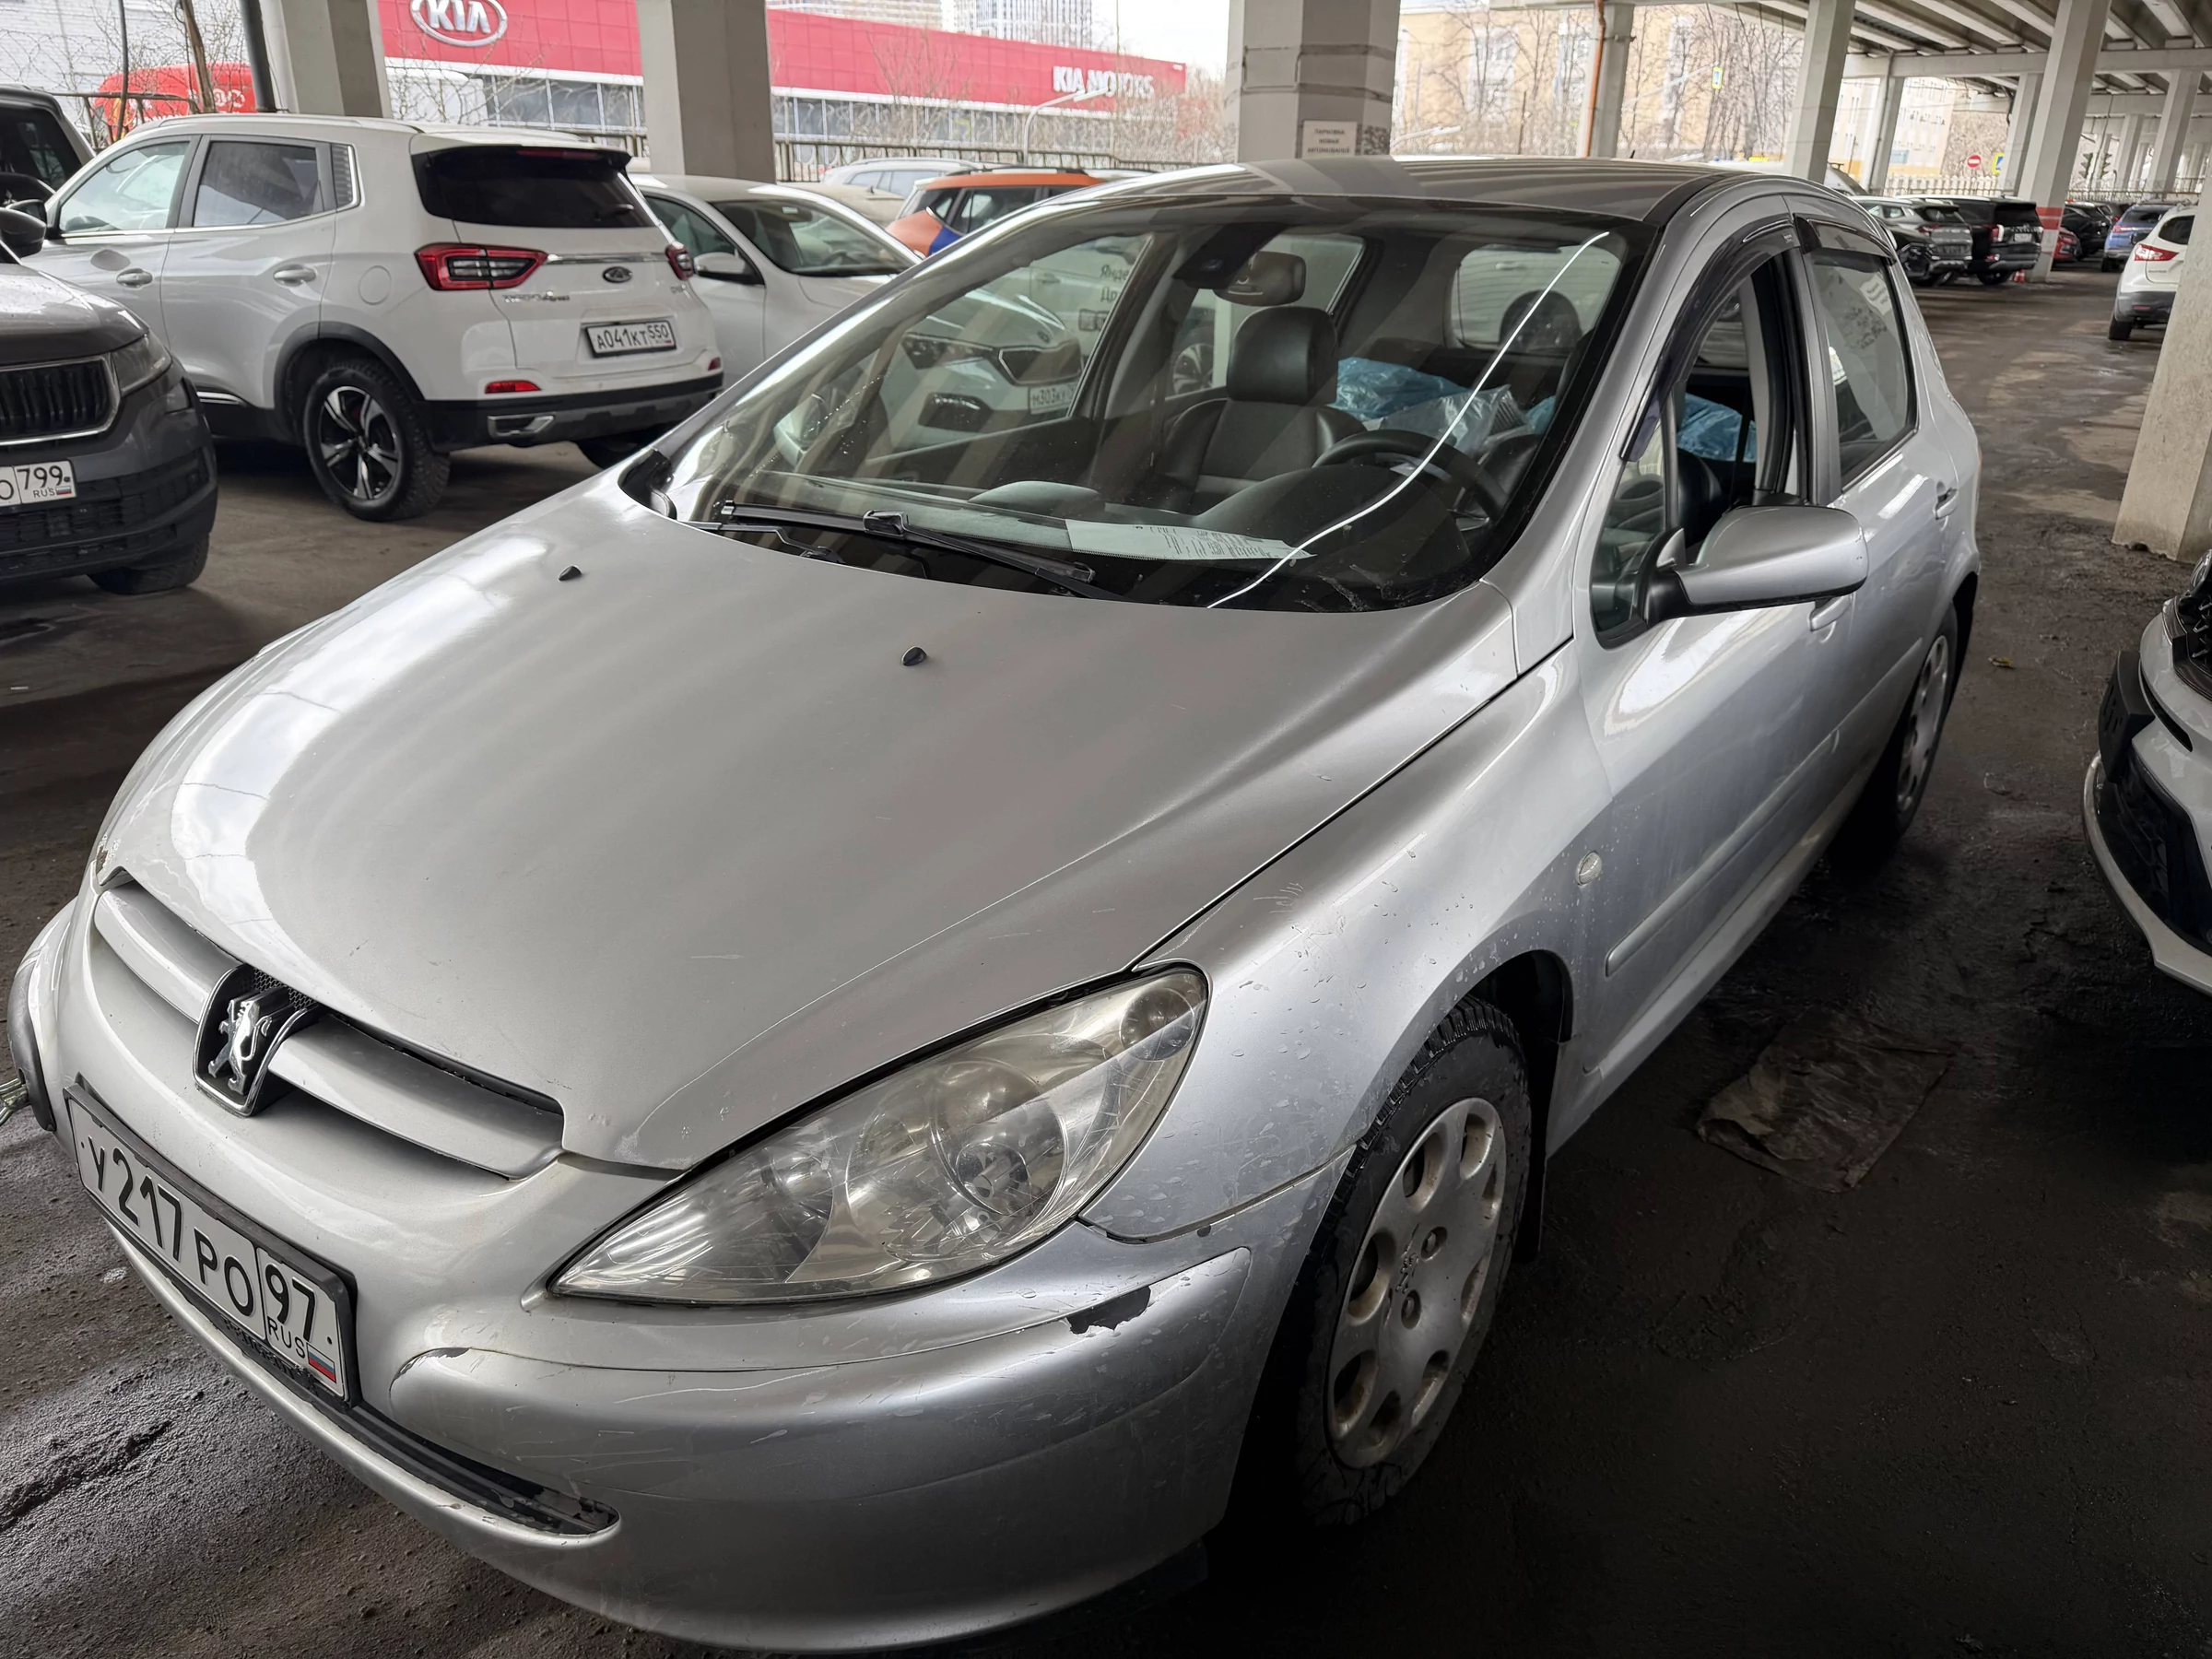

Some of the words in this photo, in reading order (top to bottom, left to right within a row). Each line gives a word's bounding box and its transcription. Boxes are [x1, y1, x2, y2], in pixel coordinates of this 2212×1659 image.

[428, 0, 491, 33] KIA
[1053, 65, 1085, 92] KIA
[1100, 264, 1130, 284] Янде
[17, 465, 63, 490] 799
[33, 488, 55, 498] RUS
[267, 1315, 306, 1359] RUS
